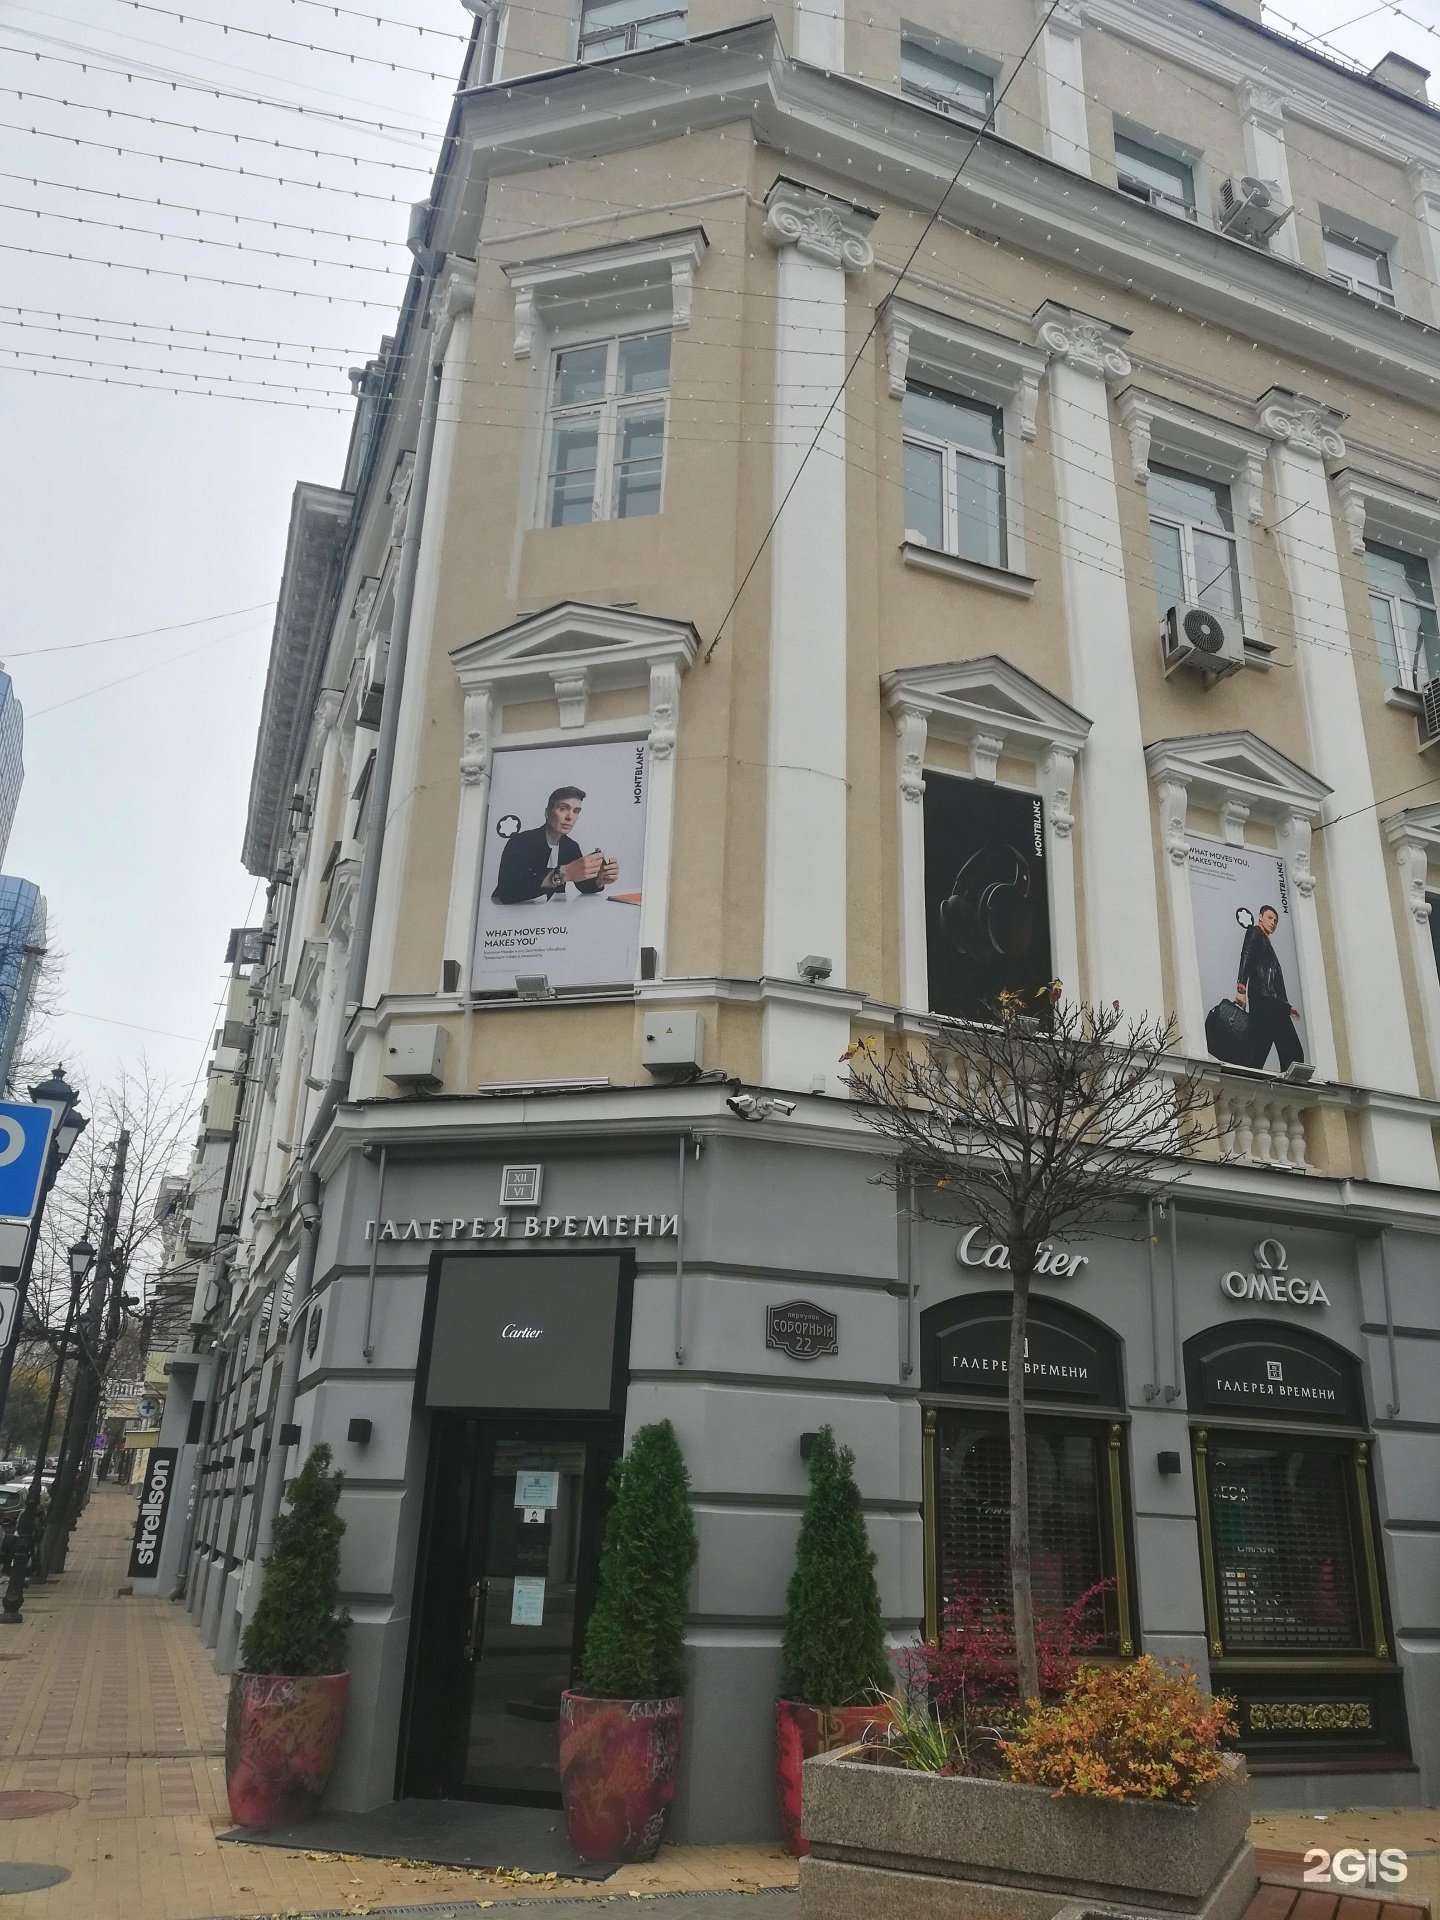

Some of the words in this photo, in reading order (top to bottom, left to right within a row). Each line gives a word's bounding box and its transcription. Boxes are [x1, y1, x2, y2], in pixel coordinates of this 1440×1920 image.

[633, 746, 645, 804] MONTBLANC
[1032, 800, 1043, 857] MONTBLANC
[1188, 855, 1212, 866] MAKES
[1189, 847, 1209, 857] WHAT
[1209, 851, 1233, 864] MOVES
[1276, 861, 1289, 914] MONTBLANC
[484, 938, 515, 948] MAKES
[485, 929, 513, 938] WHAT
[514, 927, 546, 937] MOVES
[547, 926, 569, 935] YOU,
[364, 1216, 508, 1240] ГАЛЕРЕЯ
[523, 1213, 680, 1238] ВРЕМЕНИ
[959, 1224, 1089, 1277] Catier
[1220, 1270, 1332, 1306] OMEGA
[501, 1322, 545, 1340] Cartier
[773, 1319, 833, 1338] СОБОРНЫЙ
[795, 1336, 812, 1352] 22
[952, 1356, 1009, 1372] ГАЛЕРЕ
[1024, 1362, 1089, 1379] ВРЕМЕНИ
[1216, 1379, 1274, 1395] ГАЛЕРЕЯ
[1279, 1385, 1336, 1400] ВРЕМЕНИ
[136, 1458, 171, 1566] strellson
